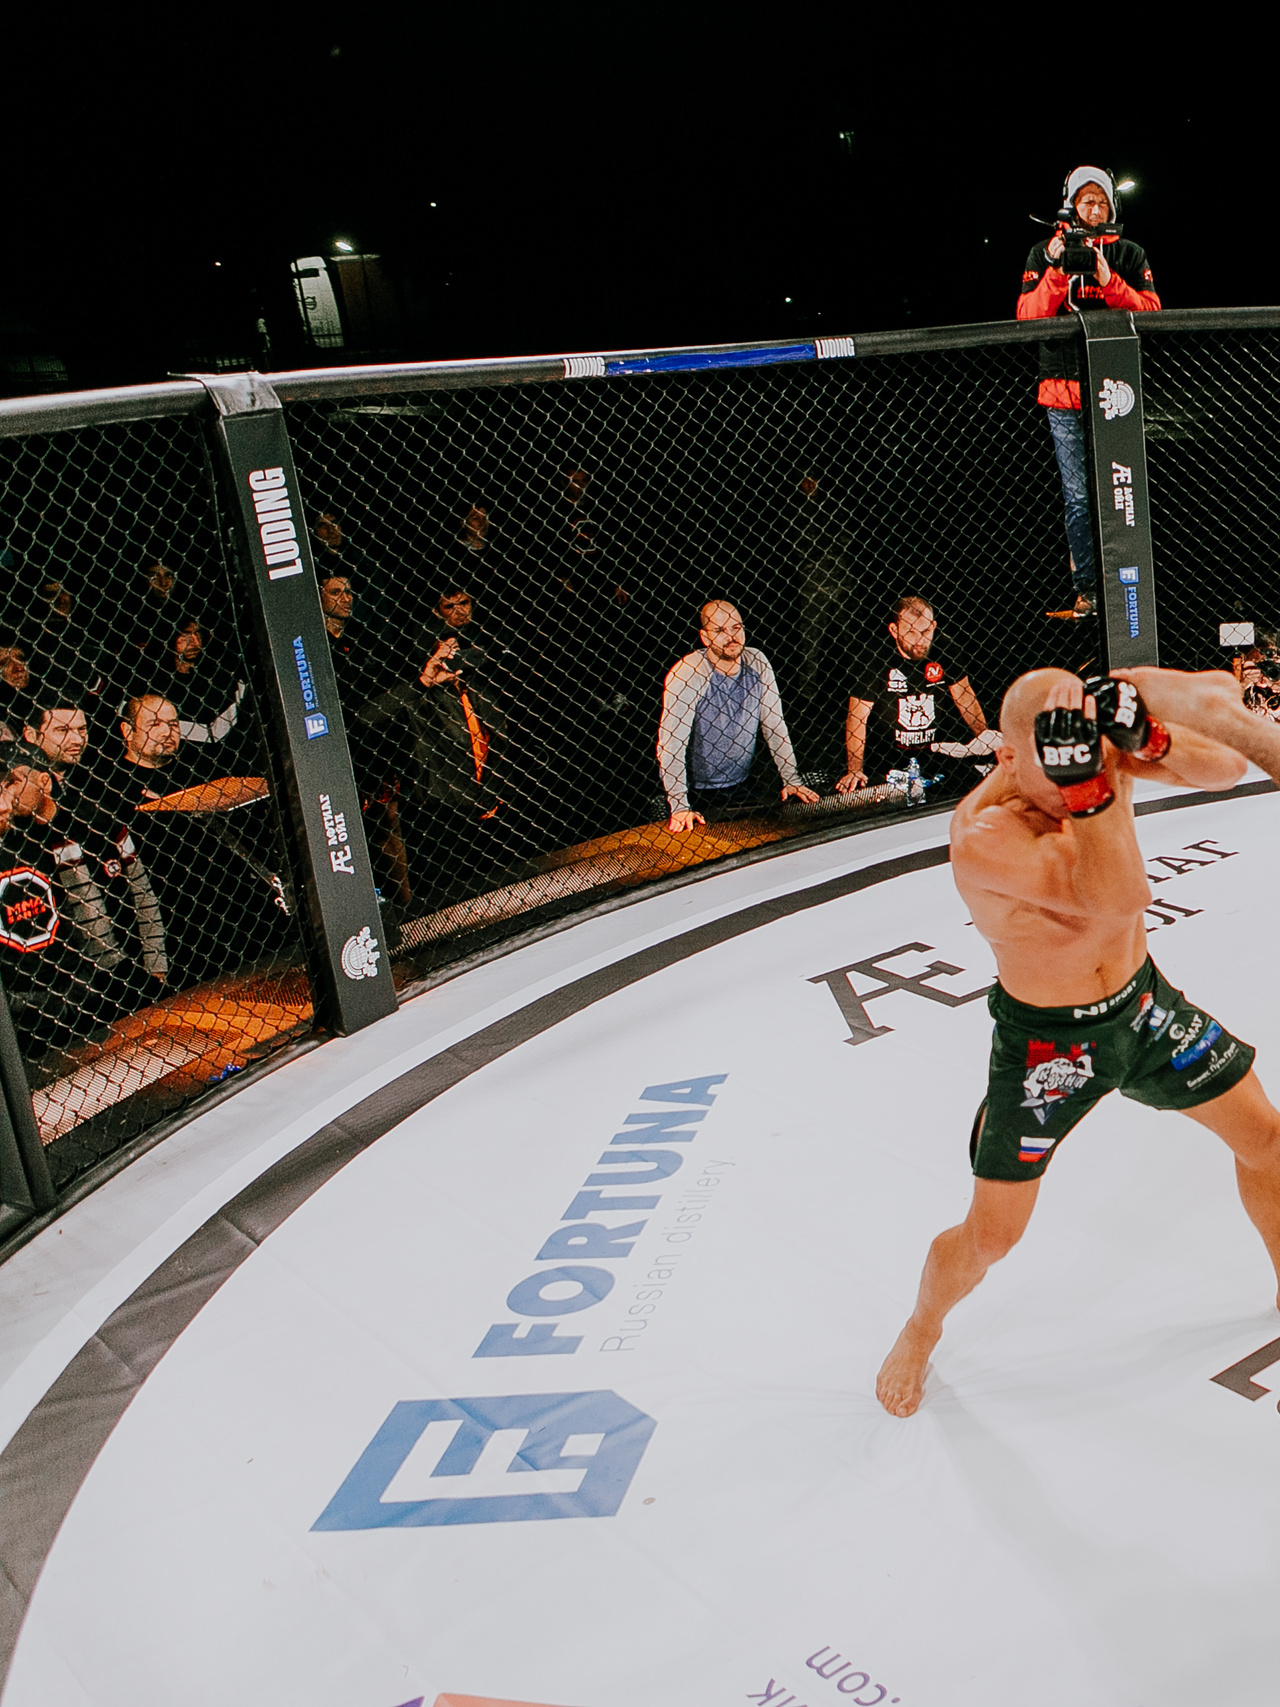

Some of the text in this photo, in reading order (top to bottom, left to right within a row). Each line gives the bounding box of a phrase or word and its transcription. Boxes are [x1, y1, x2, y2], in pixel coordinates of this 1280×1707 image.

[249, 466, 303, 579] LUDING
[1128, 586, 1139, 639] FORTUNA
[292, 635, 316, 711] FORTUNA
[1114, 681, 1138, 728] BFC
[1042, 743, 1092, 766] BFC
[471, 1072, 731, 1359] FORTUNA
[600, 1158, 737, 1353] Russian distillery
